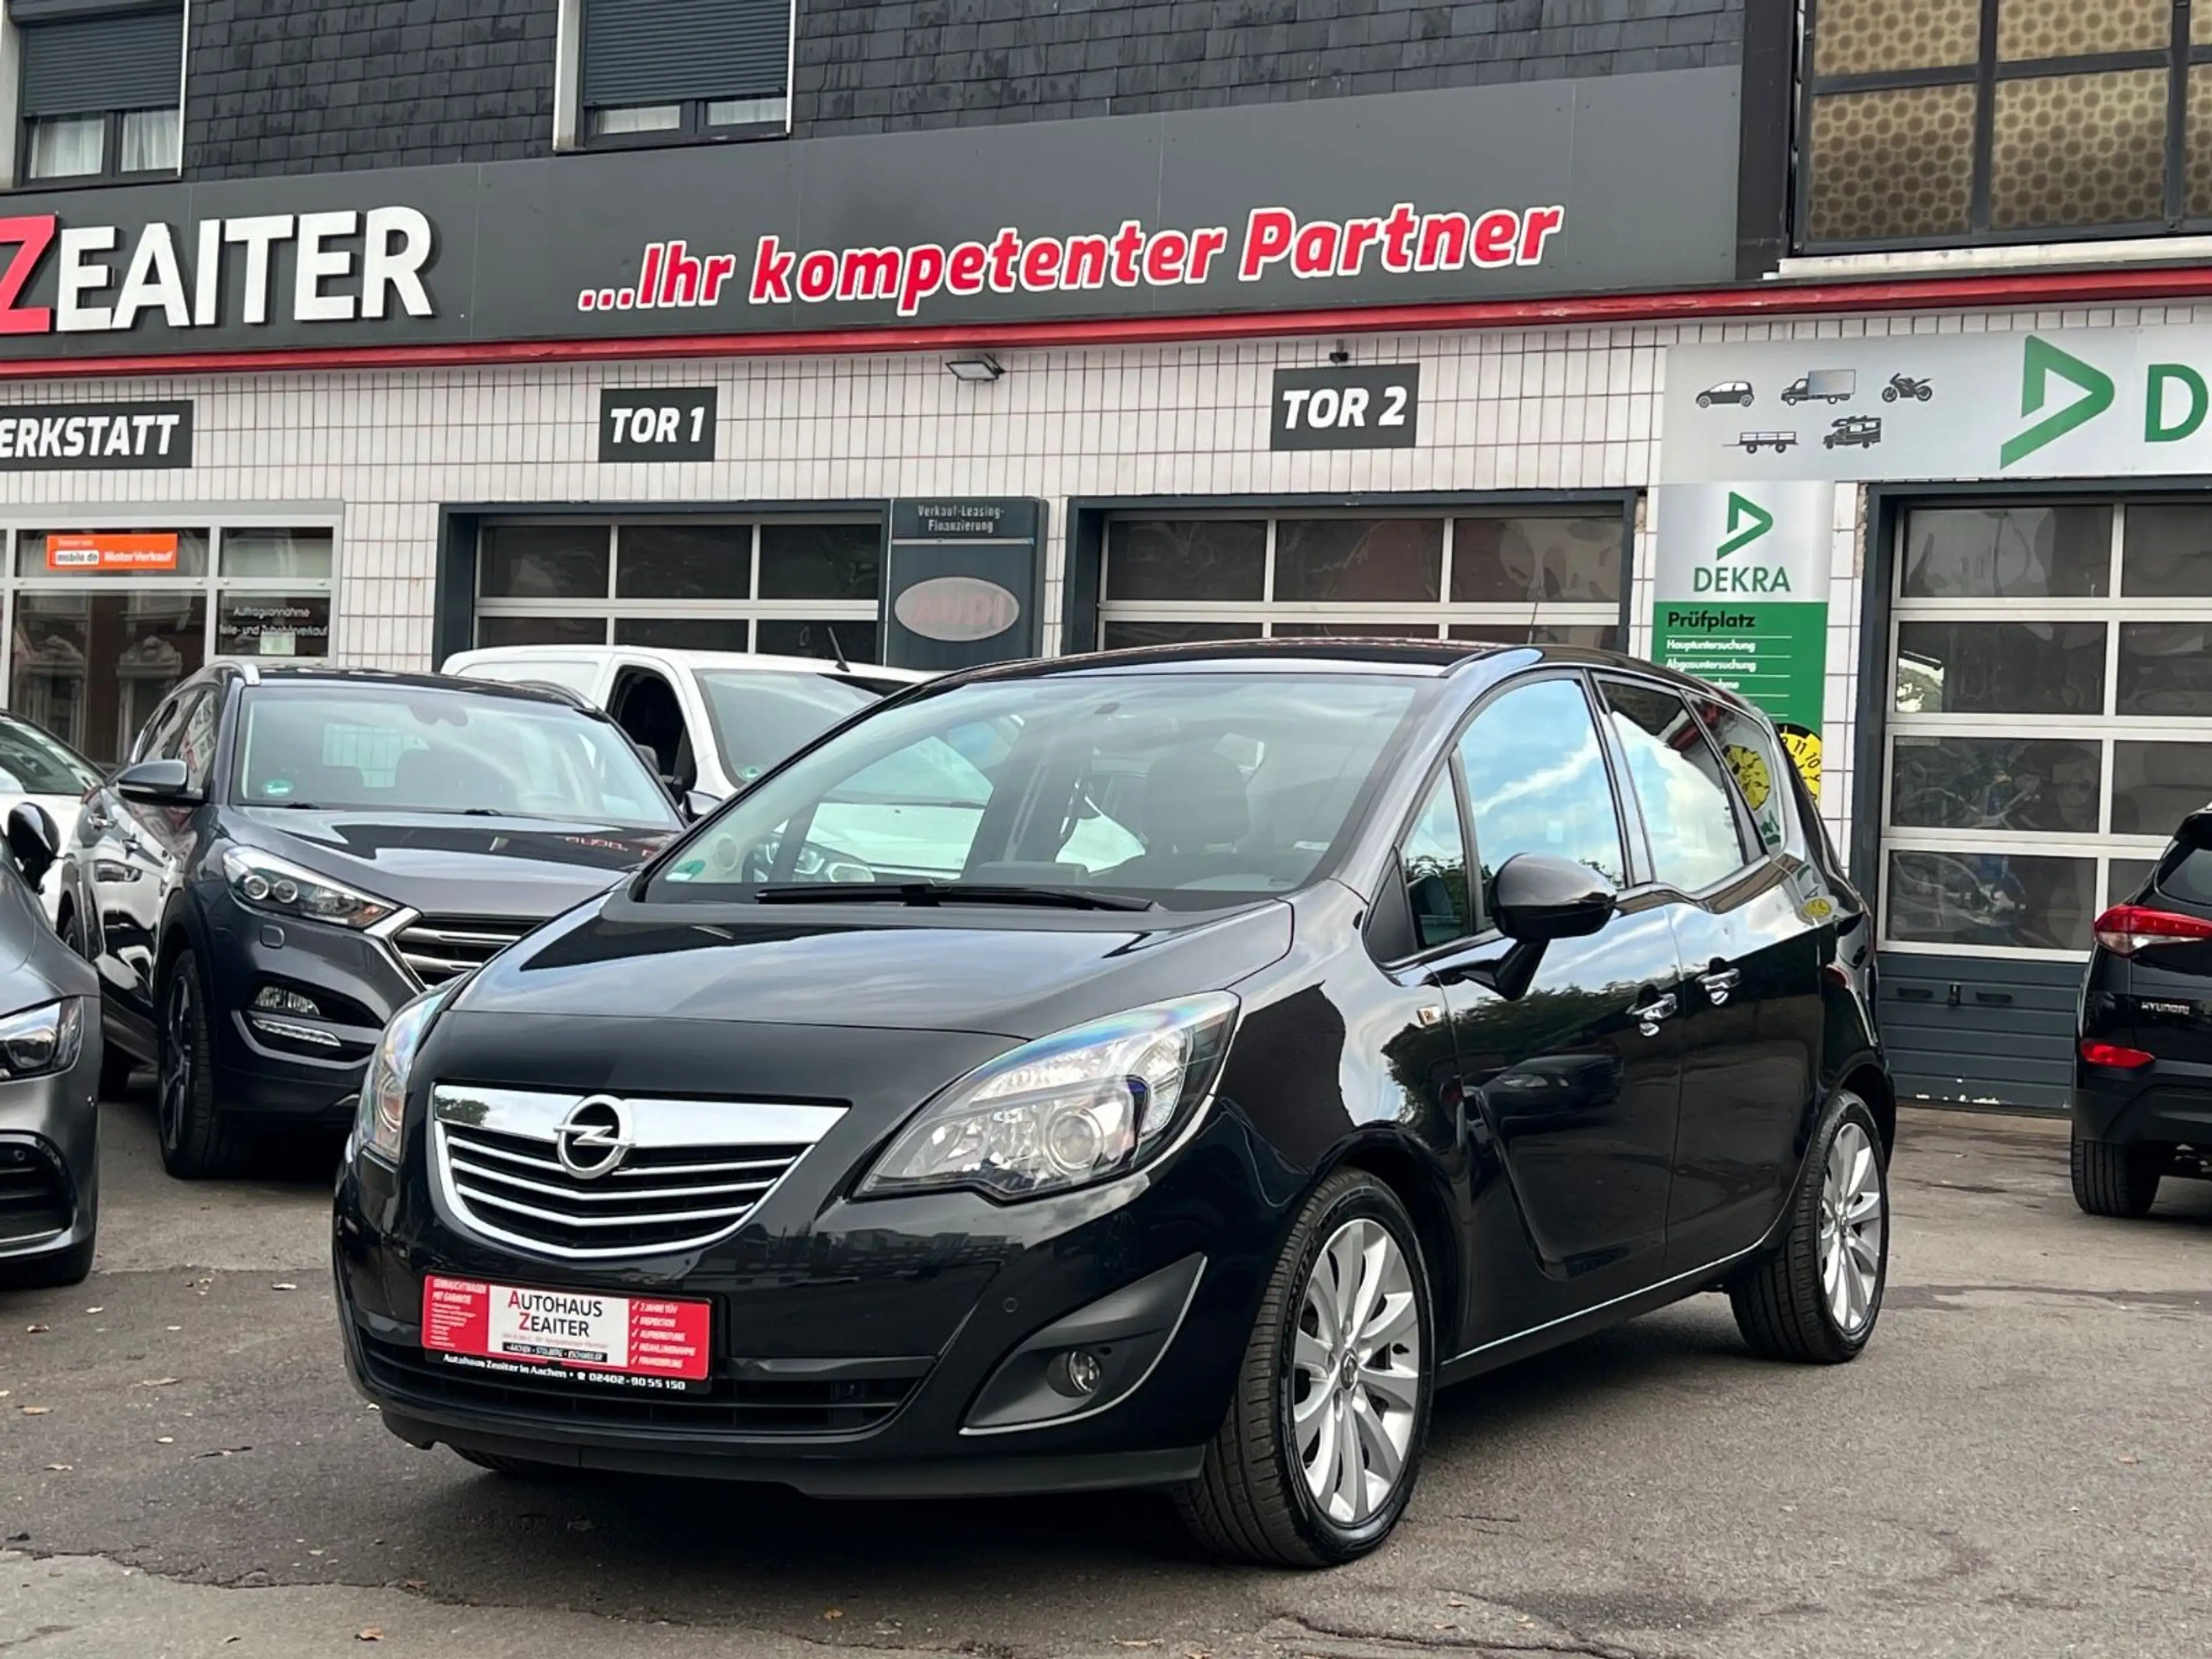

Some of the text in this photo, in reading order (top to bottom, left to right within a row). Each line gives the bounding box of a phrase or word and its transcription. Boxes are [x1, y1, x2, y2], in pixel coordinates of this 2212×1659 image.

[0, 206, 434, 334] ZEAITER
[749, 220, 1227, 317] kompetenter
[1238, 202, 1565, 282] Partner
[1283, 386, 1407, 430] TOR 2
[610, 407, 704, 443] TOR 1
[928, 519, 994, 533] Finanzierung
[1693, 566, 1791, 592] DEKRA
[1668, 611, 1756, 632] Prüfplatz
[1666, 638, 1756, 653] Hauptuntersuchung
[1666, 657, 1757, 673] Abgasuntersuchung
[507, 1290, 603, 1317] AUTOHAUS
[518, 1312, 590, 1338] ZEAITER
[531, 1366, 567, 1379] Aachen
